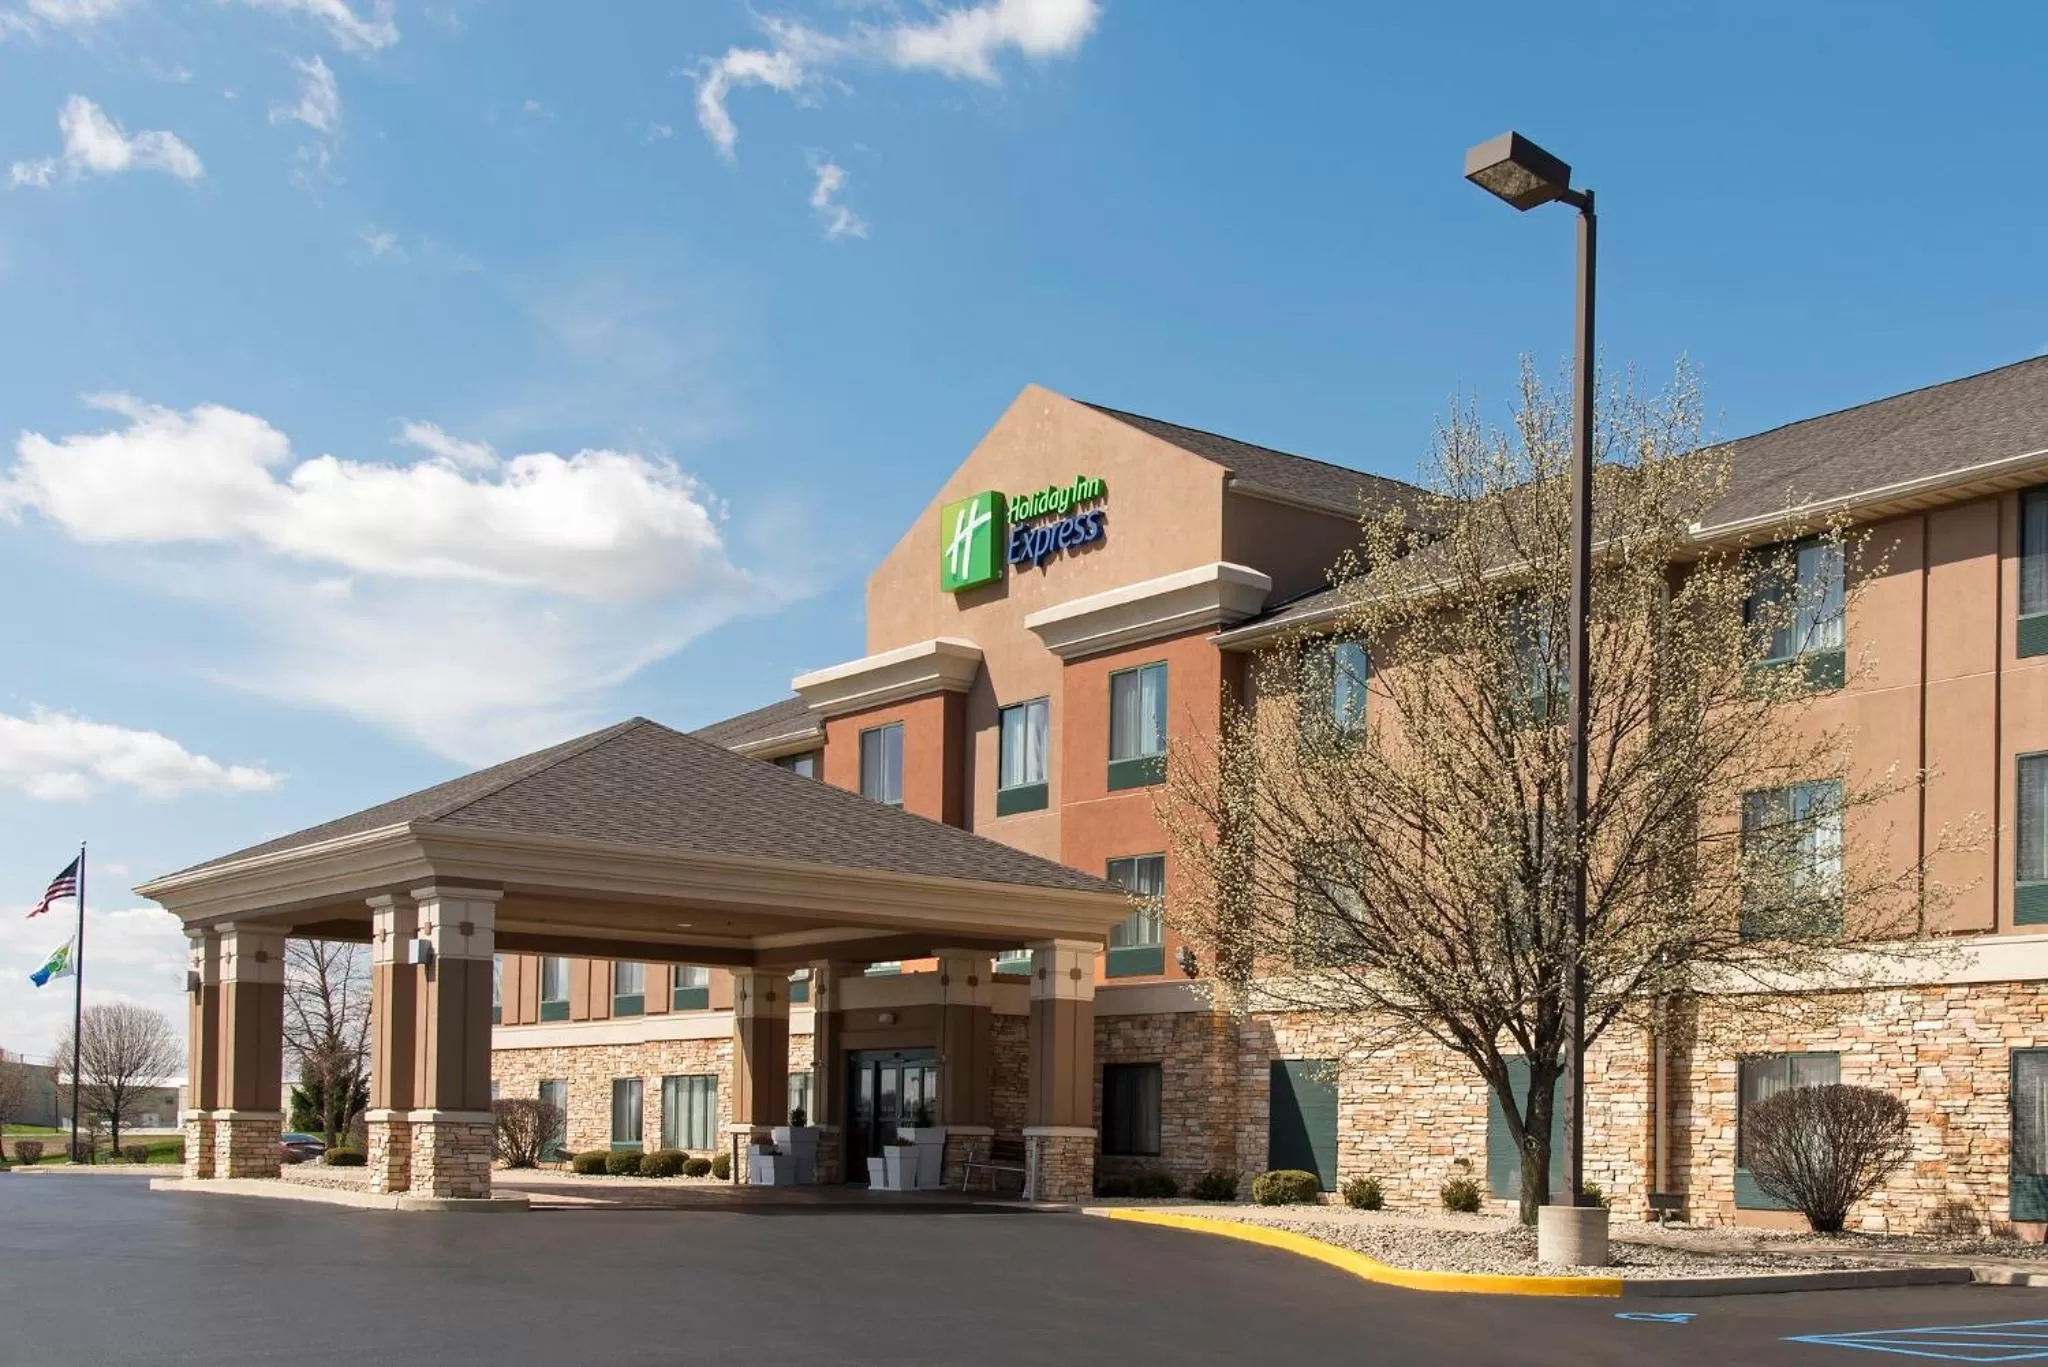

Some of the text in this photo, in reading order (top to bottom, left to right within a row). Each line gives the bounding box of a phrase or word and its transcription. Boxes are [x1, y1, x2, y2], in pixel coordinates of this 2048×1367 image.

[1007, 474, 1101, 524] Holiday Inn
[1008, 509, 1101, 567] Express
